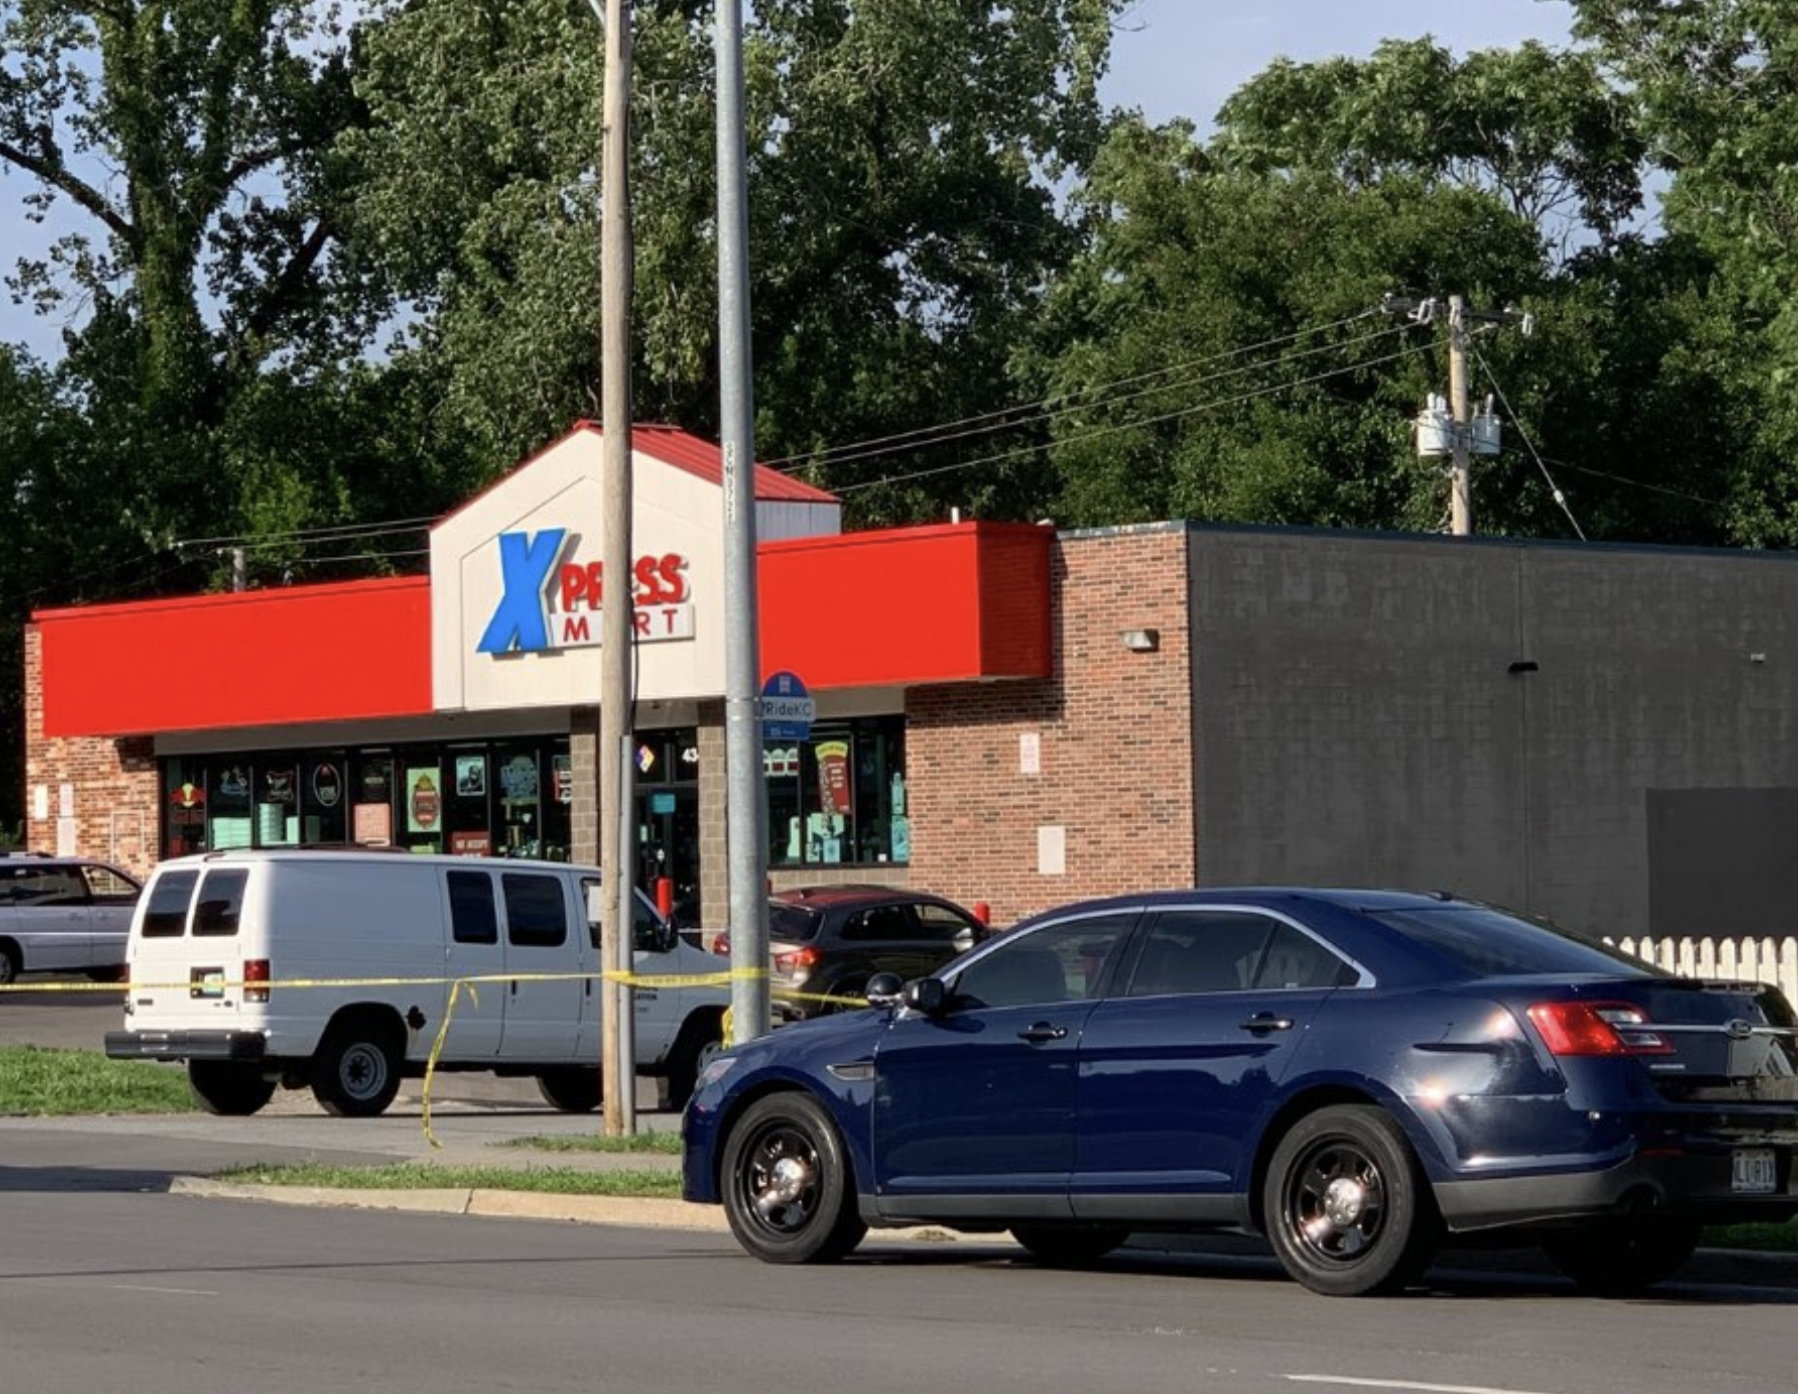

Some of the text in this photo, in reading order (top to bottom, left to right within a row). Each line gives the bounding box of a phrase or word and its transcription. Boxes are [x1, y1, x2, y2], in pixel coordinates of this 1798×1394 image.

[476, 527, 685, 653] XPRSS
[563, 609, 678, 642] MRT
[766, 702, 812, 716] RideKC
